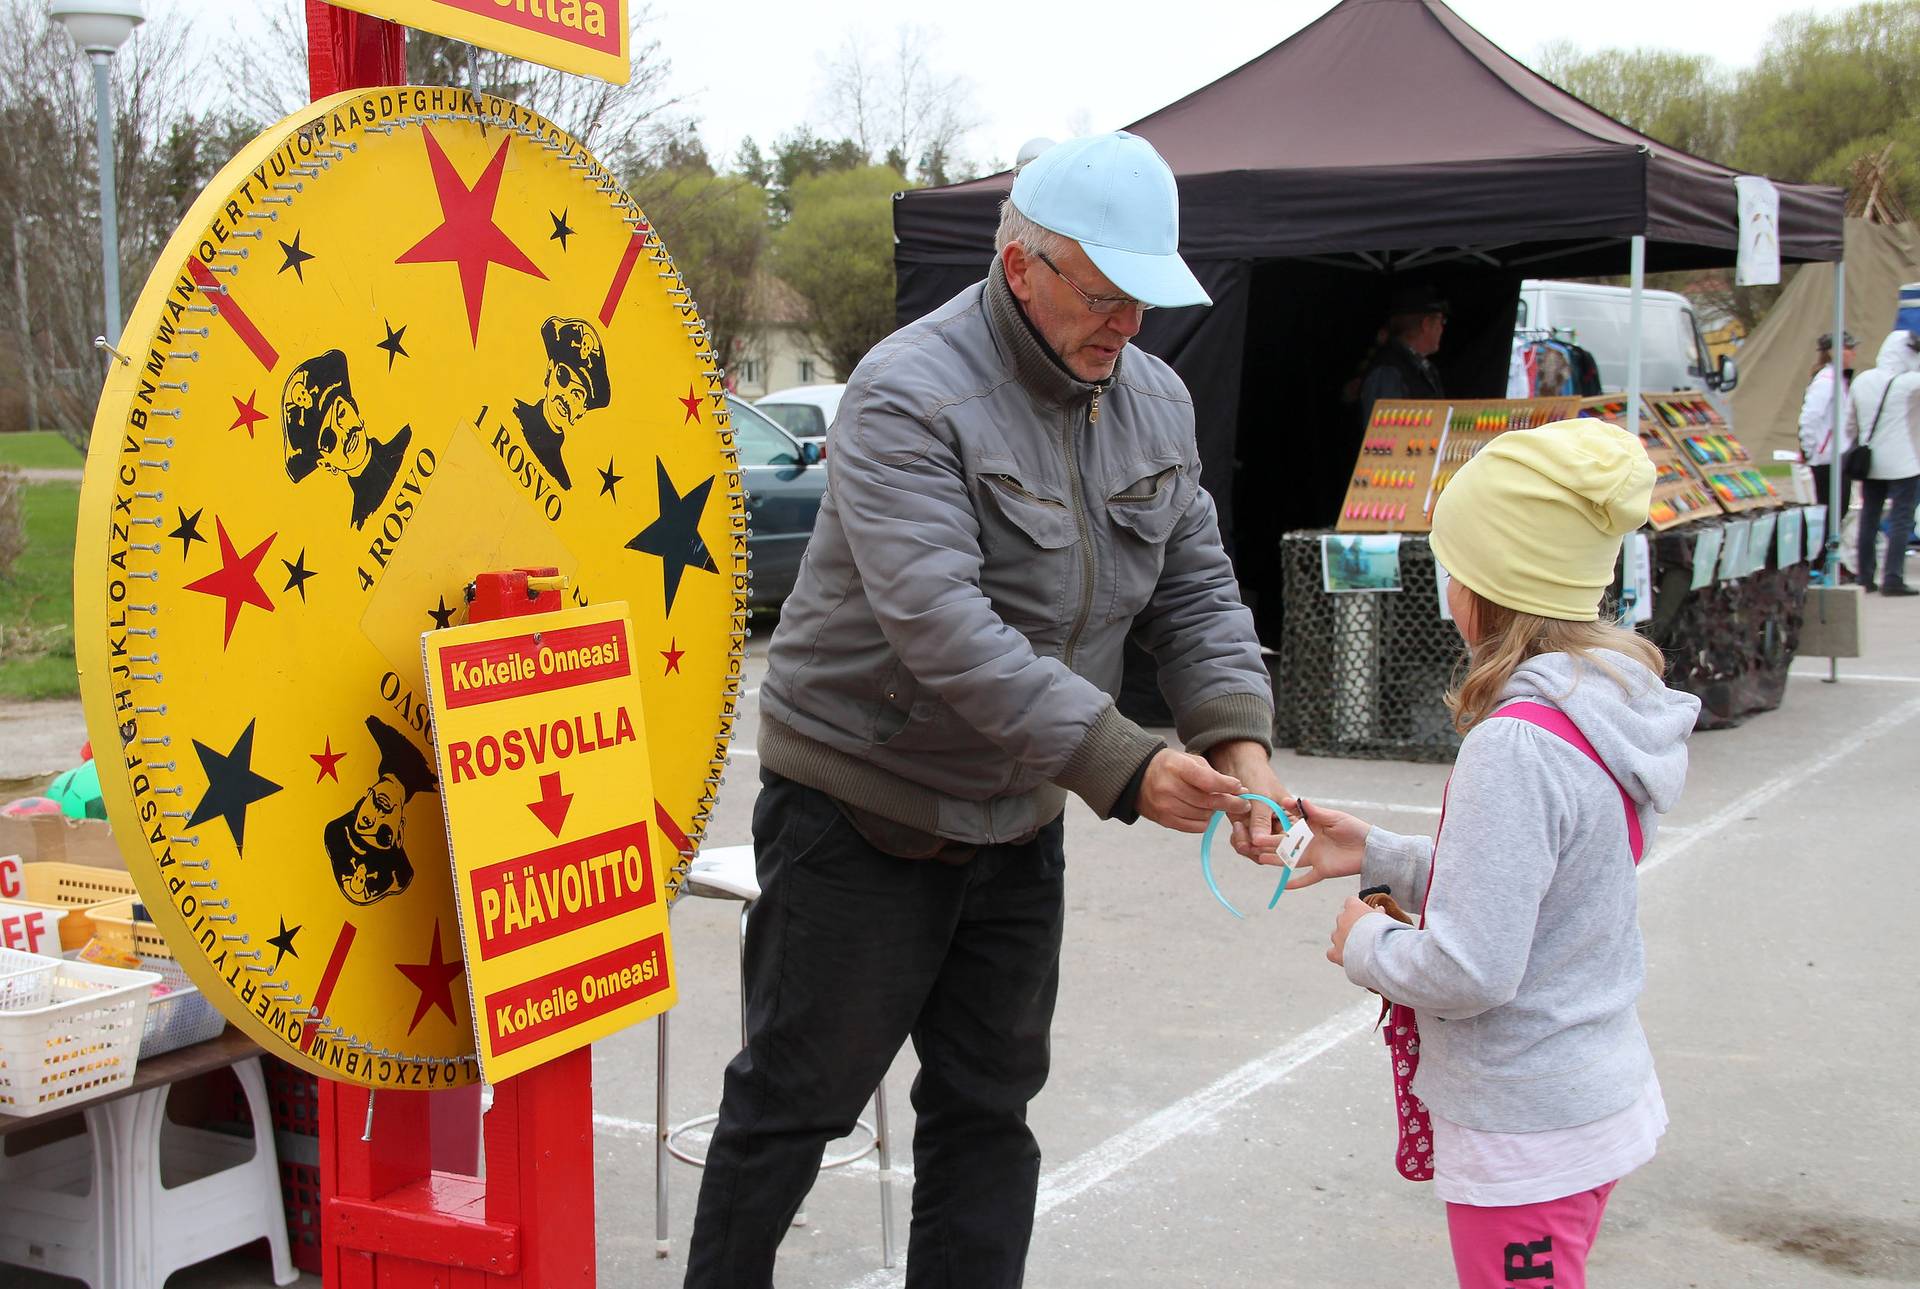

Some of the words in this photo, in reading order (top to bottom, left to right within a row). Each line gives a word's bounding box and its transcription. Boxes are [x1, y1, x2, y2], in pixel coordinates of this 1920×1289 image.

[494, 0, 606, 38] ttaa
[491, 423, 563, 522] ROSVO
[355, 565, 375, 593] 4
[368, 447, 436, 569] ROSVO
[450, 653, 536, 691] Kokeile
[538, 635, 620, 675] Onneasi
[448, 706, 636, 784] ROSVOLLA
[0, 911, 45, 954] EF
[480, 845, 643, 940] PÄÄVOITTO
[496, 986, 578, 1038] Kokeile
[581, 950, 660, 1004] Onneasi
